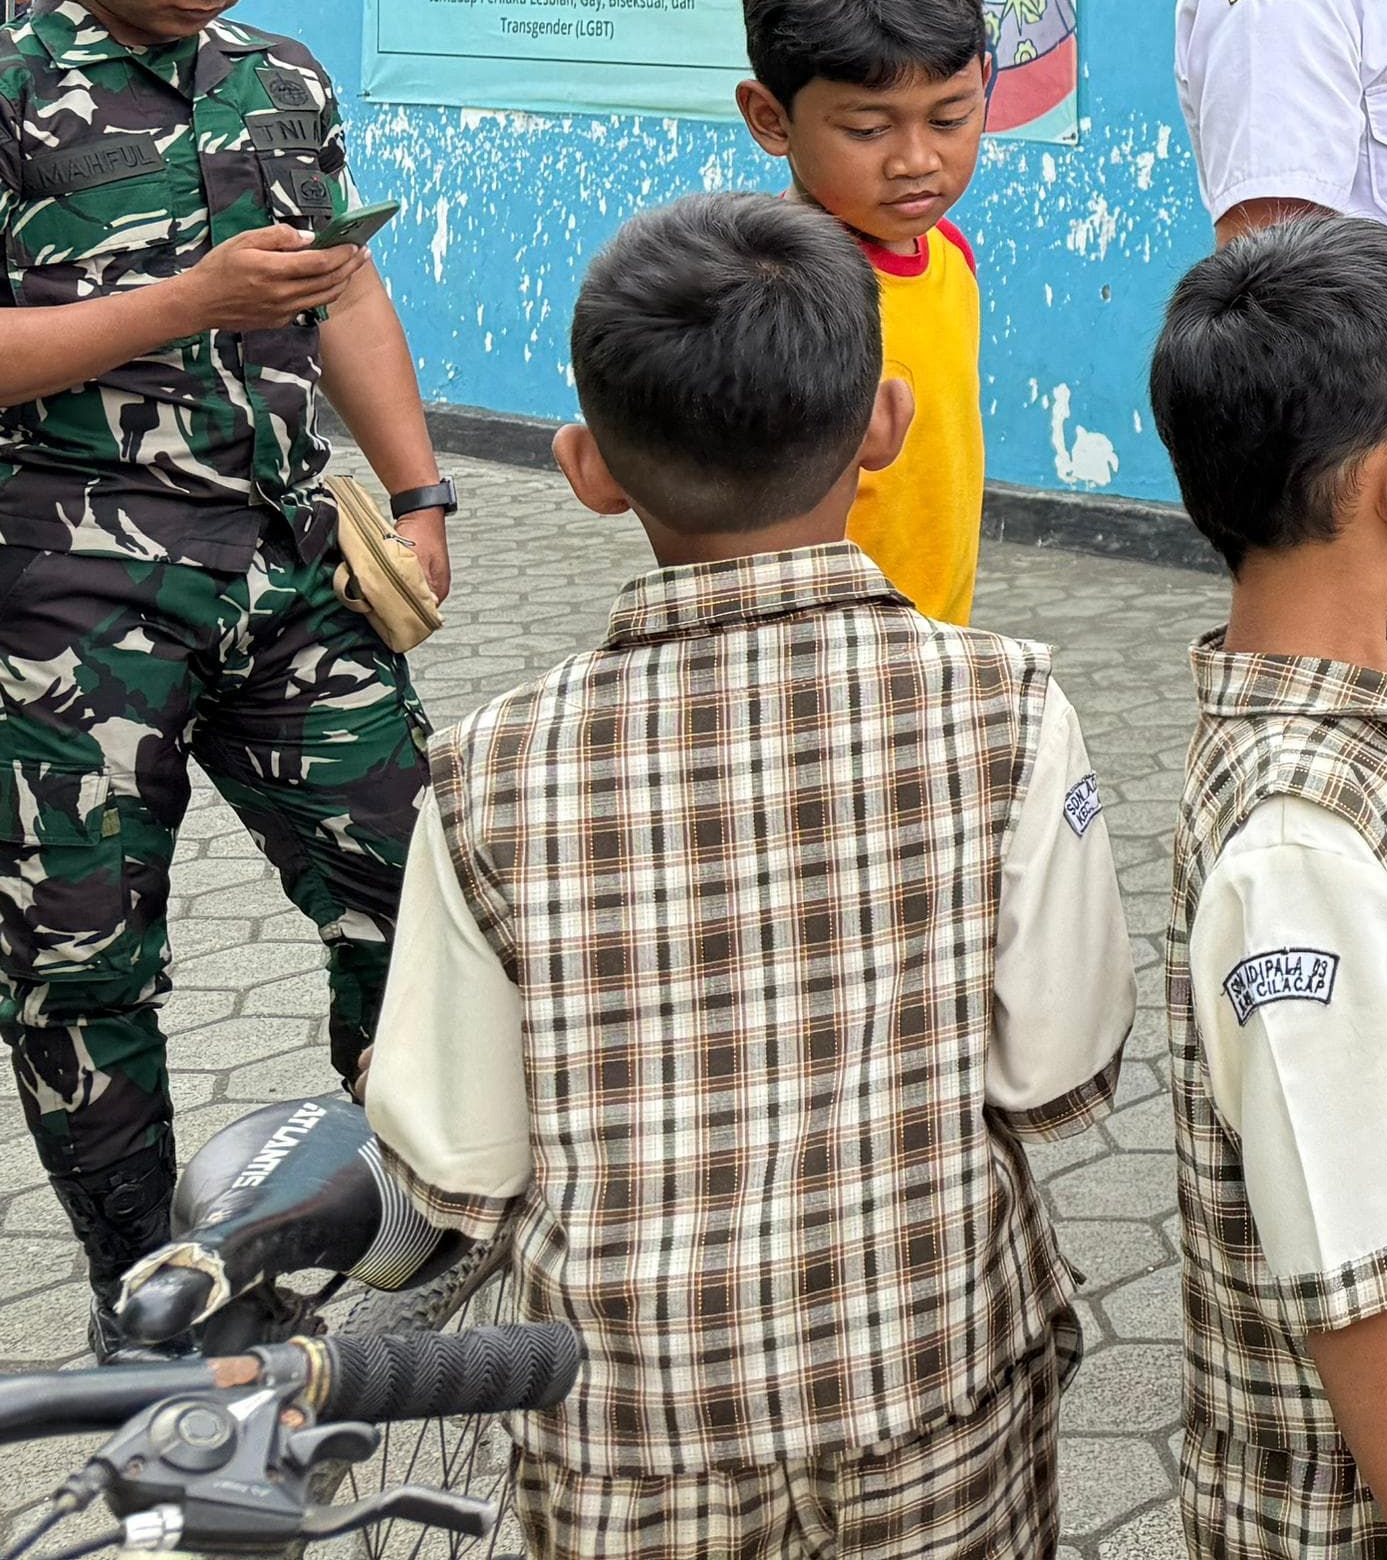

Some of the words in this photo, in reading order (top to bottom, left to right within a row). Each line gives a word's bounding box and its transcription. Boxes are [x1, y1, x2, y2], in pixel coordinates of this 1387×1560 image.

[499, 16, 574, 37] Transgender
[575, 18, 614, 40] (LGBT)
[255, 122, 306, 143] TNI
[1311, 957, 1328, 978] 03
[1256, 975, 1326, 997] CILACAP
[231, 1102, 327, 1189] ATLANTIS
